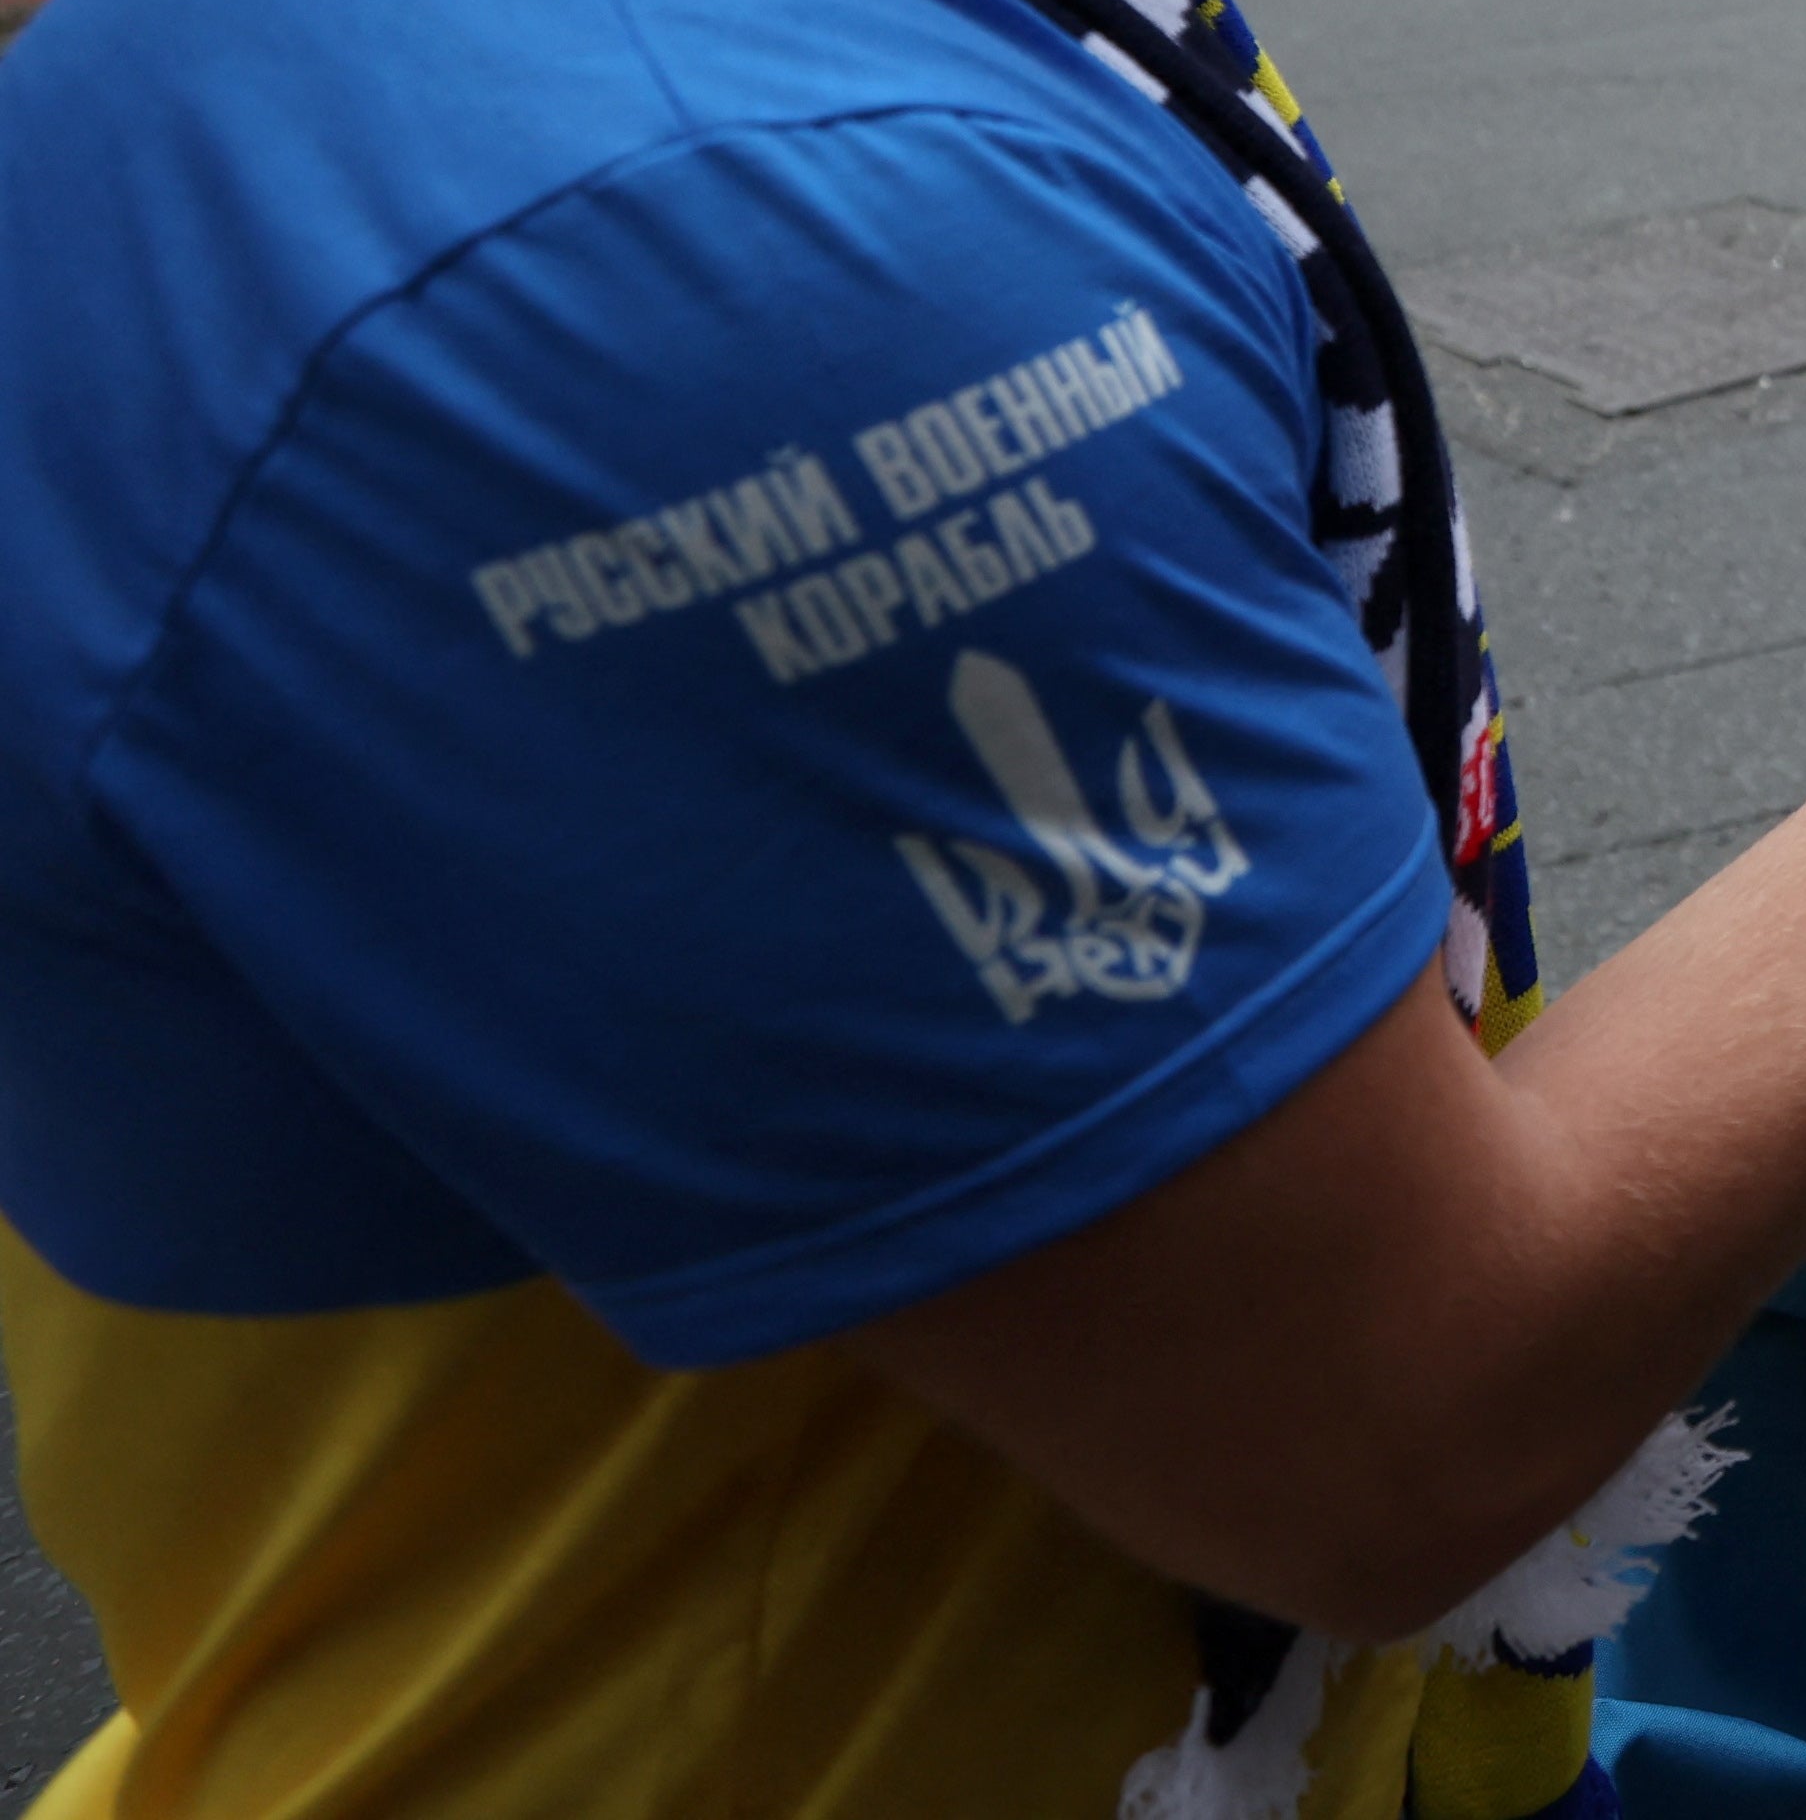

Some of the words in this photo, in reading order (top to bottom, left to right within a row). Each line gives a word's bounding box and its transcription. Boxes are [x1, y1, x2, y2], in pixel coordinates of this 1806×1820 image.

[470, 442, 862, 660] РУССКИЙ
[853, 299, 1184, 522] ВОЕННЫЙ
[732, 476, 1096, 686] КОРАБЛЬ
